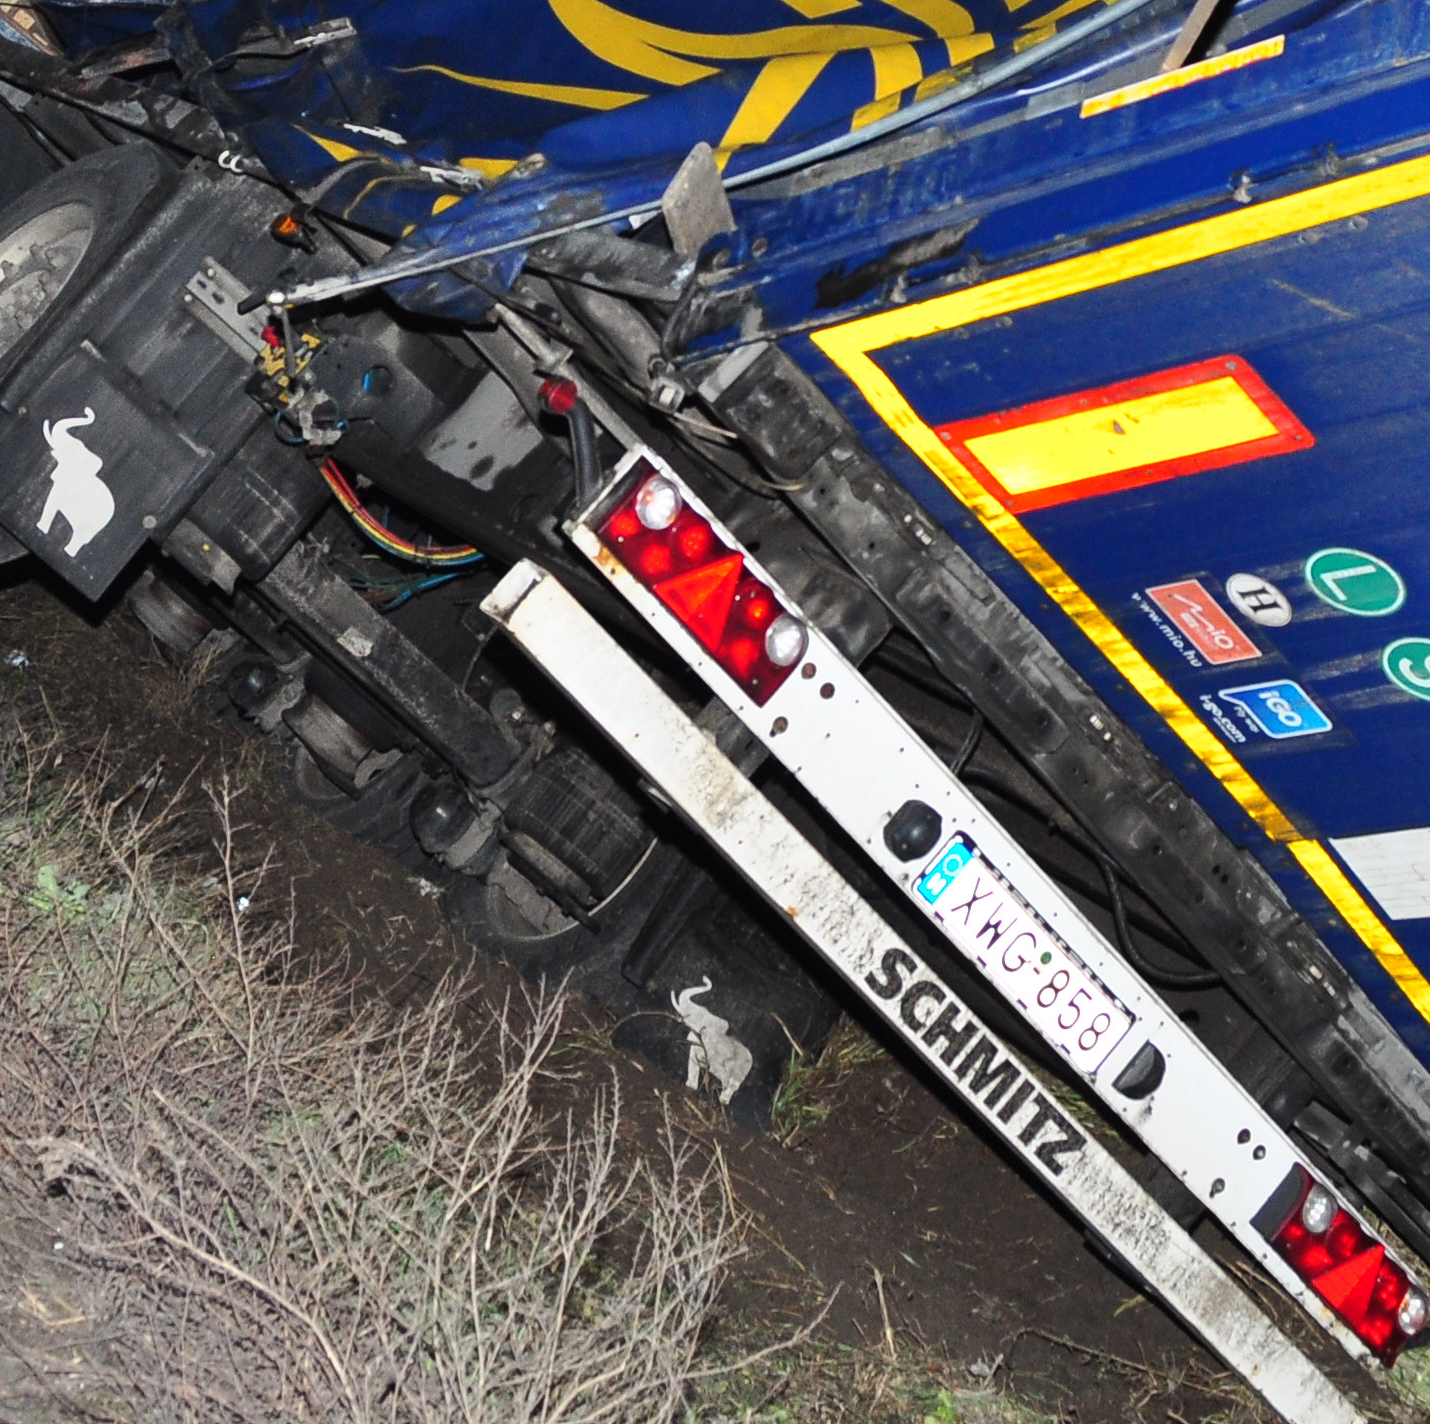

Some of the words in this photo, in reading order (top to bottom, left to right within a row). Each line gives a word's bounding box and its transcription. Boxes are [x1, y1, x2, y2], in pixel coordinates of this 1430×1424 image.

[1237, 583, 1282, 616] H
[1319, 565, 1377, 601] L
[950, 877, 1112, 1052] XWG-858
[864, 947, 1089, 1177] SCHMITZ
